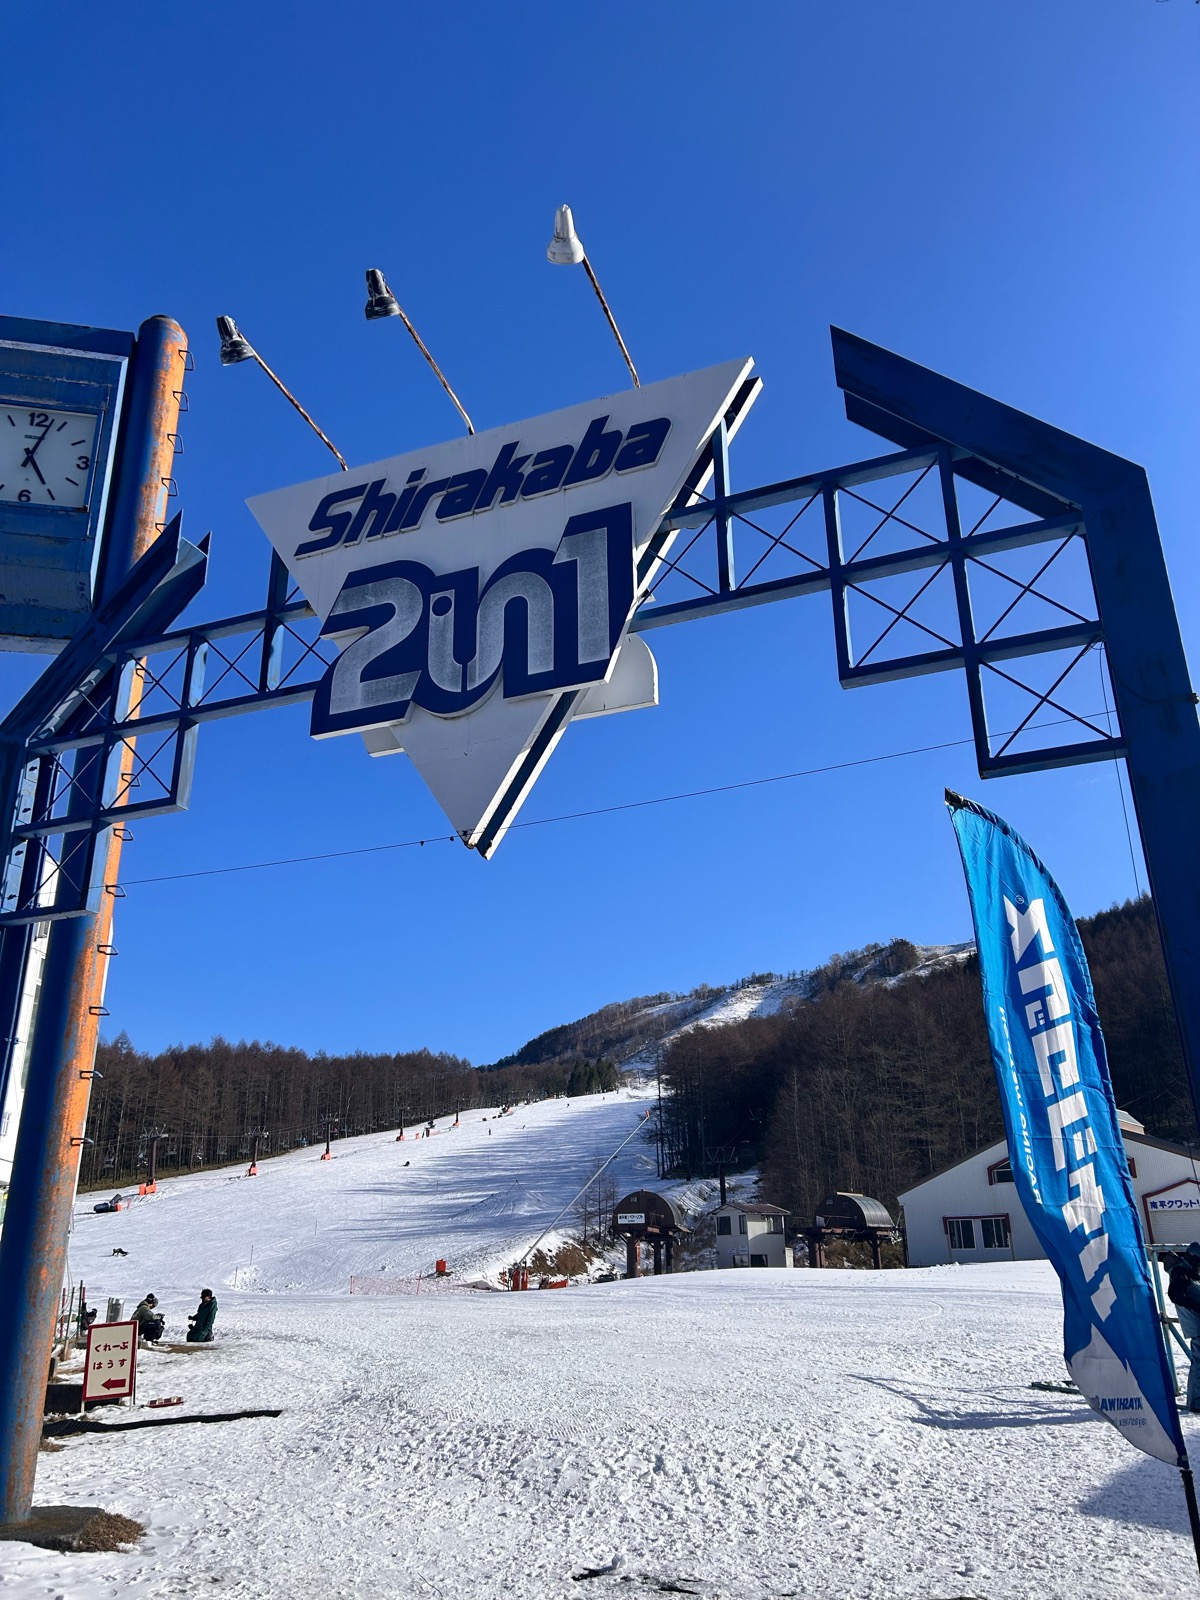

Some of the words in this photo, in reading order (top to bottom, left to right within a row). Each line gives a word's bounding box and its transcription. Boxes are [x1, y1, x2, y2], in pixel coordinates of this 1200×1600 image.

[28, 412, 50, 427] 12
[76, 455, 90, 470] 3
[294, 414, 673, 558] Shirakaba
[18, 489, 32, 503] 6
[93, 1358, 127, 1370] はうす
